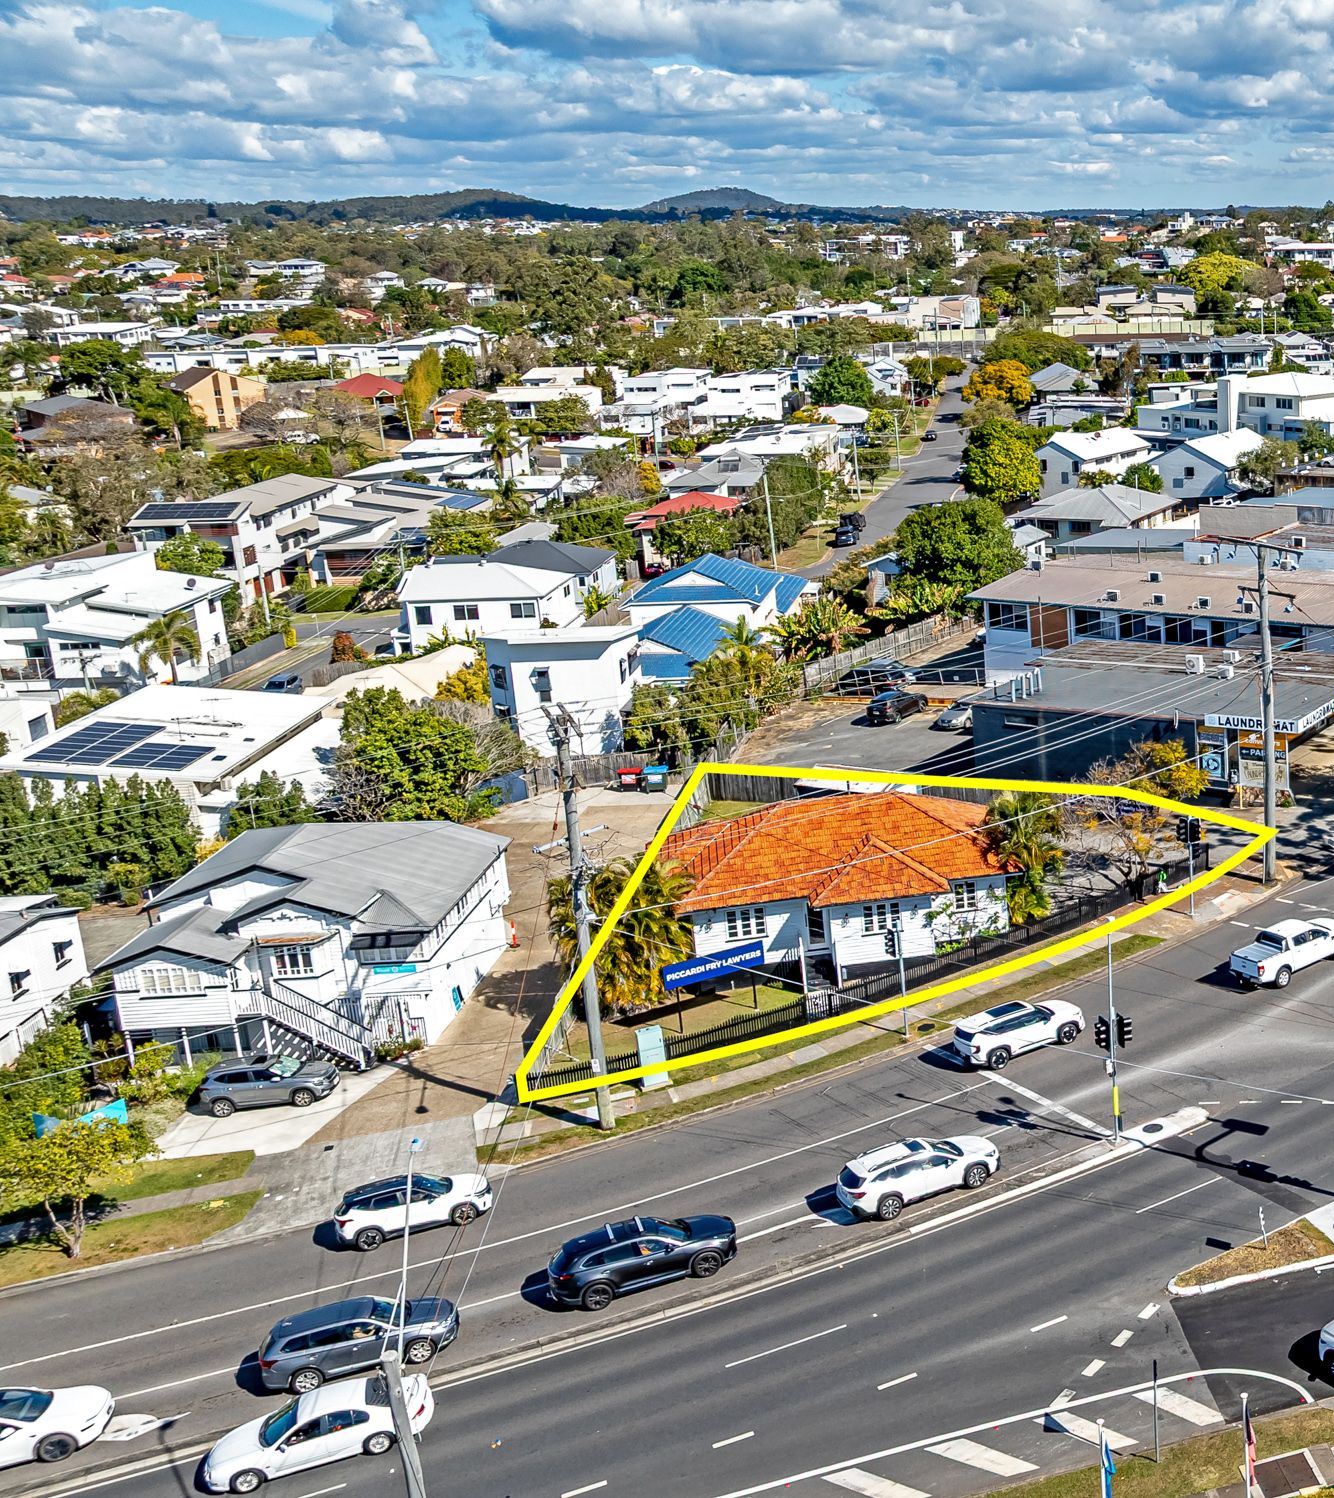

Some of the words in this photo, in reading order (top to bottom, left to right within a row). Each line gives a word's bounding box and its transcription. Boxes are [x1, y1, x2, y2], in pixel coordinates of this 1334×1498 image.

[1217, 716, 1295, 732] LAUNDRMAT
[1250, 748, 1286, 759] PARNG
[666, 965, 706, 982] PICCARDI
[705, 960, 722, 972] FRY
[722, 949, 761, 967] LAWYERS
